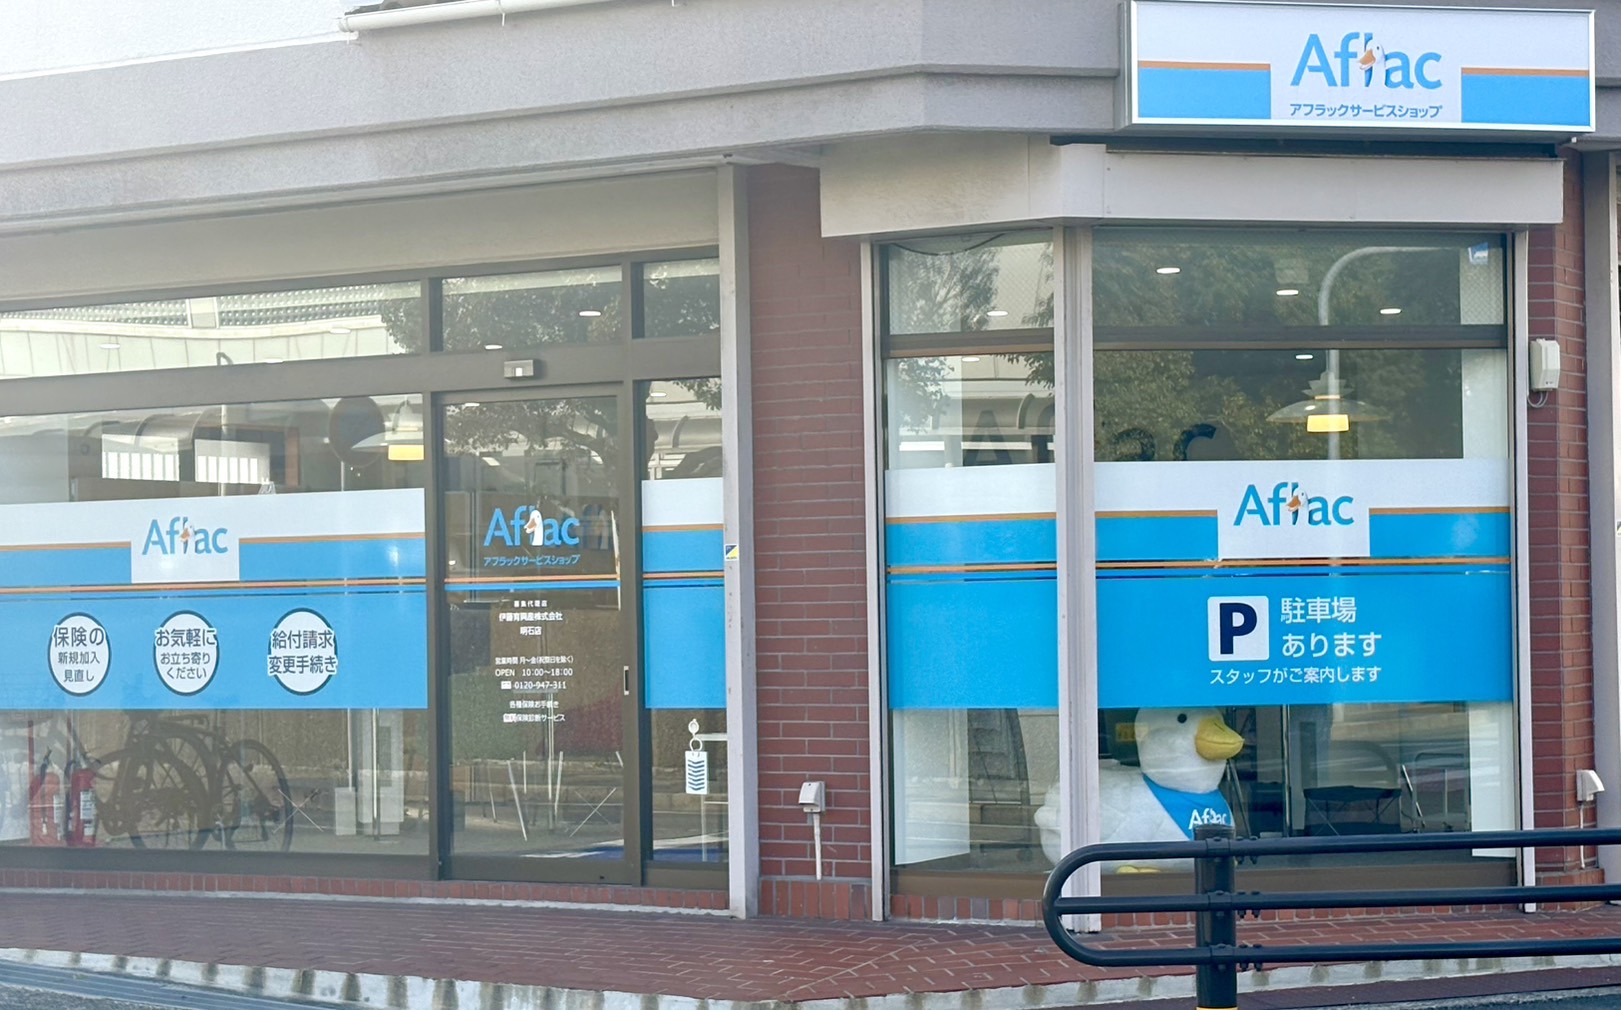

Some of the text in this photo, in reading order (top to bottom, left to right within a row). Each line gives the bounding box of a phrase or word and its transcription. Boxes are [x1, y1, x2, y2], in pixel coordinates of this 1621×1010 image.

[1290, 32, 1442, 89] Aflac
[1290, 103, 1443, 118] アフラックサービスショップ
[1233, 482, 1354, 526] Aflac
[484, 554, 581, 567] アフラックサービスショップ
[1280, 597, 1357, 624] 駐車場
[53, 626, 104, 648] 保険の
[156, 628, 216, 648] お気軽に
[1219, 603, 1257, 655] P
[272, 630, 333, 649] 給付請求
[1282, 632, 1381, 658] あります
[58, 651, 101, 665] 新規加入
[160, 652, 210, 665] お立ち寄り
[269, 655, 337, 674] 変更手続き
[64, 669, 95, 682] 見直し
[166, 666, 207, 679] ください
[495, 669, 515, 677] OPEN
[1210, 666, 1382, 685] スタッフがご案内します
[514, 681, 566, 689] 0120-947-311
